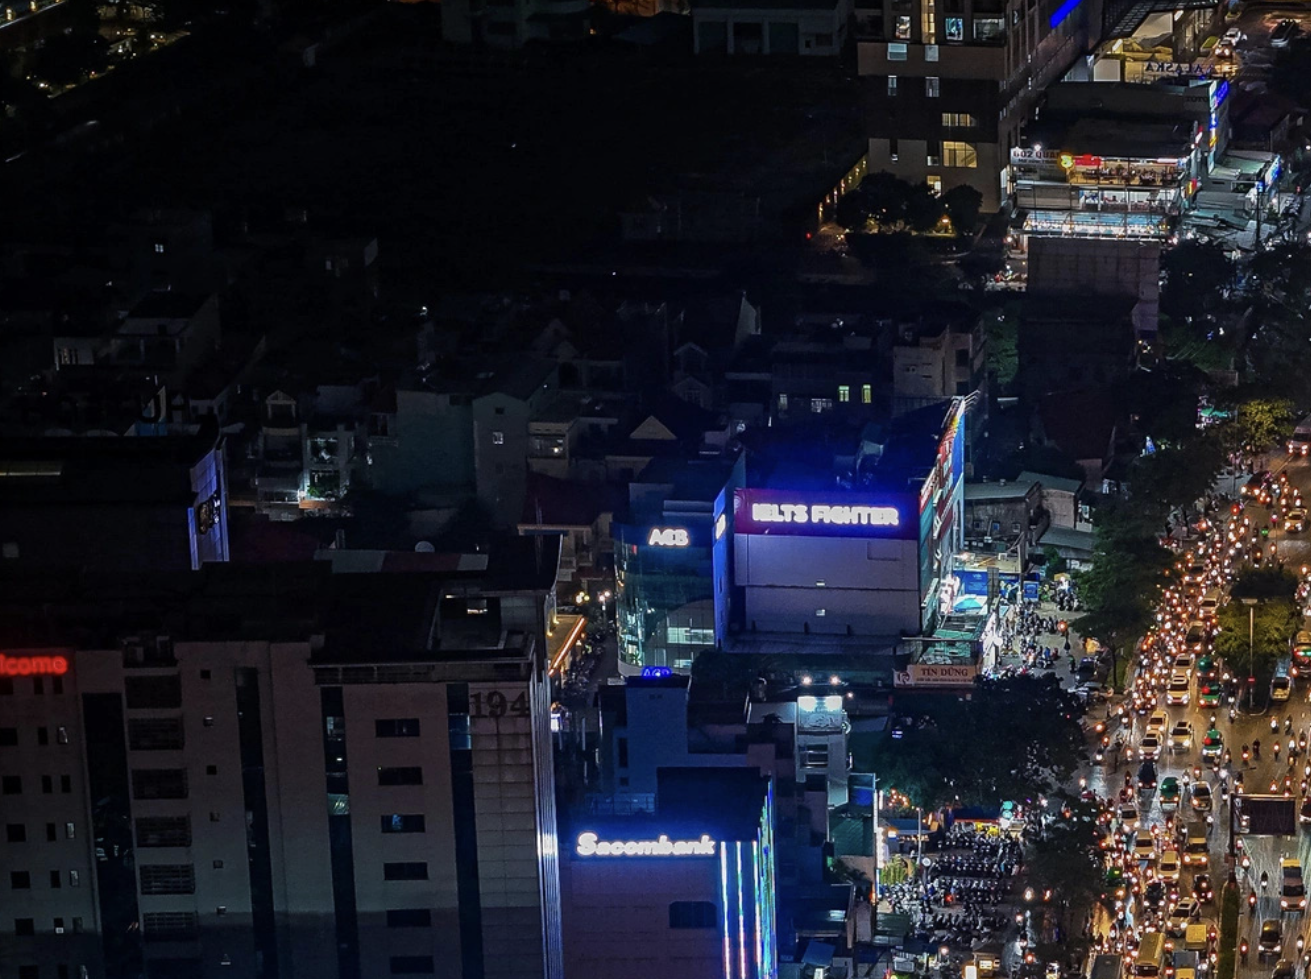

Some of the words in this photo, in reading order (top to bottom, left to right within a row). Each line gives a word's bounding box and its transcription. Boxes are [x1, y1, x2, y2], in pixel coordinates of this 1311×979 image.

[752, 503, 809, 524] IELTS
[812, 505, 899, 526] FIGHTER
[648, 528, 689, 546] ACB
[470, 691, 530, 718] 194
[577, 832, 716, 855] Sacombank
